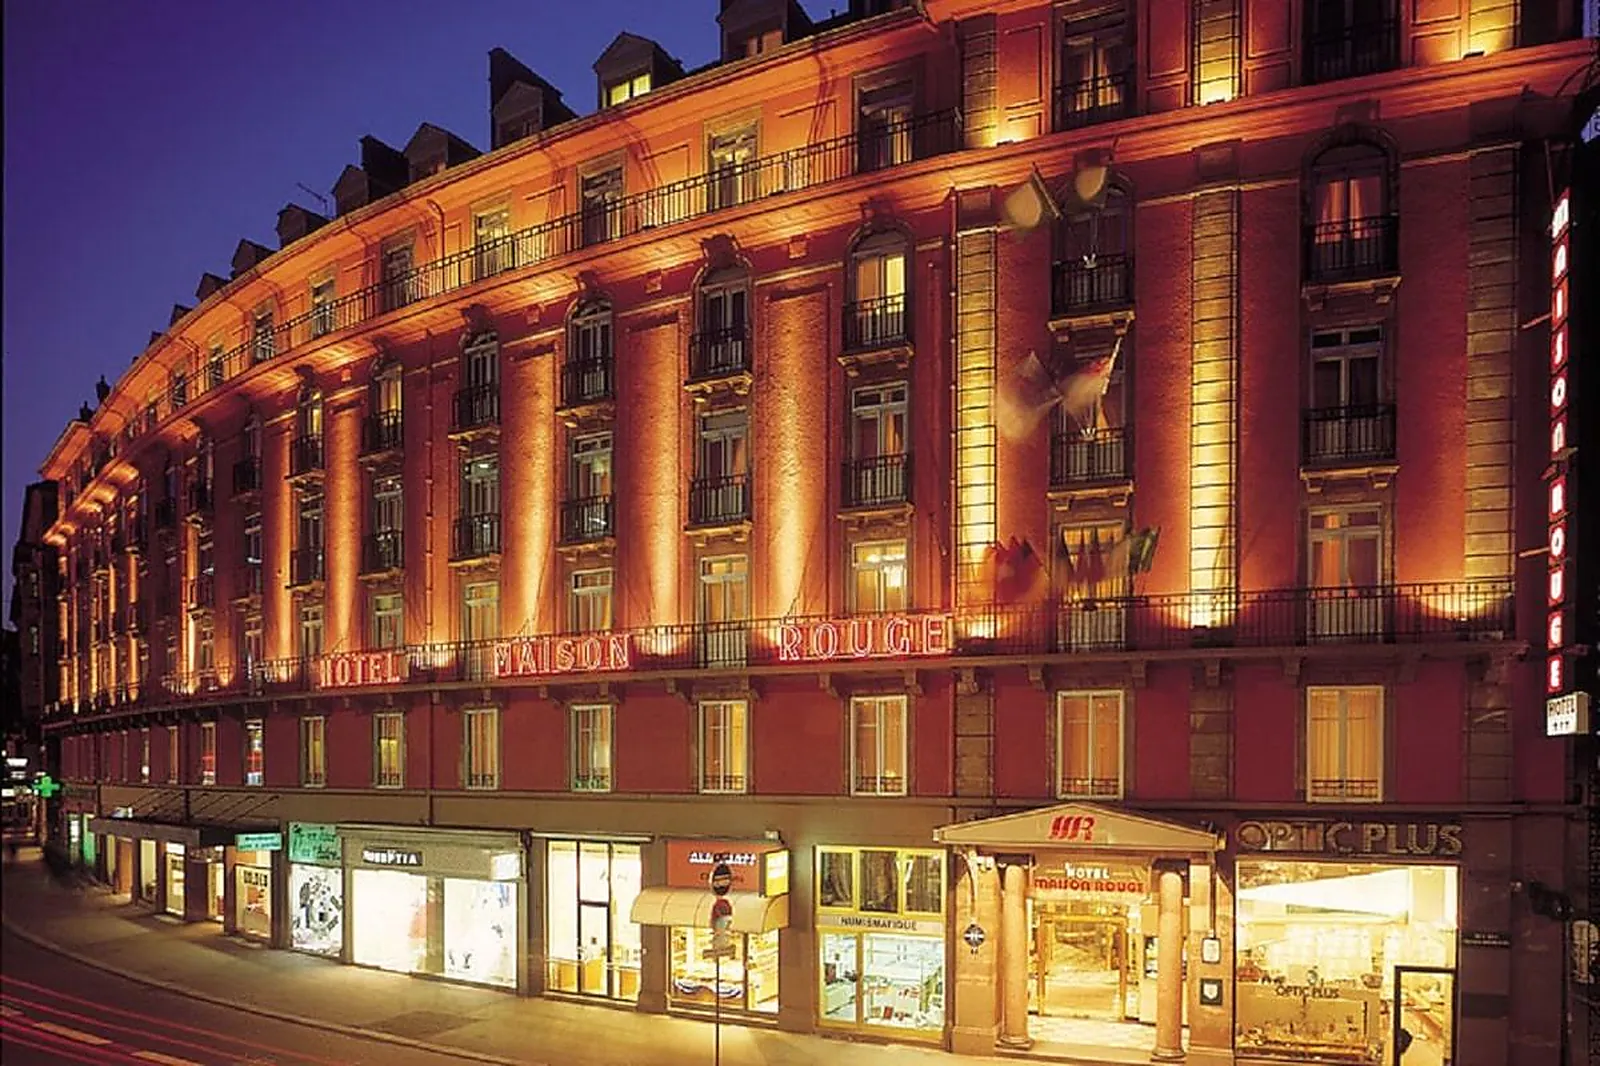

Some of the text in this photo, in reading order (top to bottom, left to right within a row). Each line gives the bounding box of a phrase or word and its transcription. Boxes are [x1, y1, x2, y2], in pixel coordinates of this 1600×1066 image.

[1551, 483, 1564, 687] ROUGE
[320, 614, 949, 687] HOTEL MAISON ROUGE
[1549, 698, 1574, 717] HOTEL
[1235, 820, 1463, 855] OPTIC PLUS
[1065, 864, 1110, 879] HOTEL
[1095, 881, 1145, 893] ROUGE
[840, 916, 918, 931] NUMISMATIQUE
[1276, 985, 1340, 999] OPTIC PLUS
